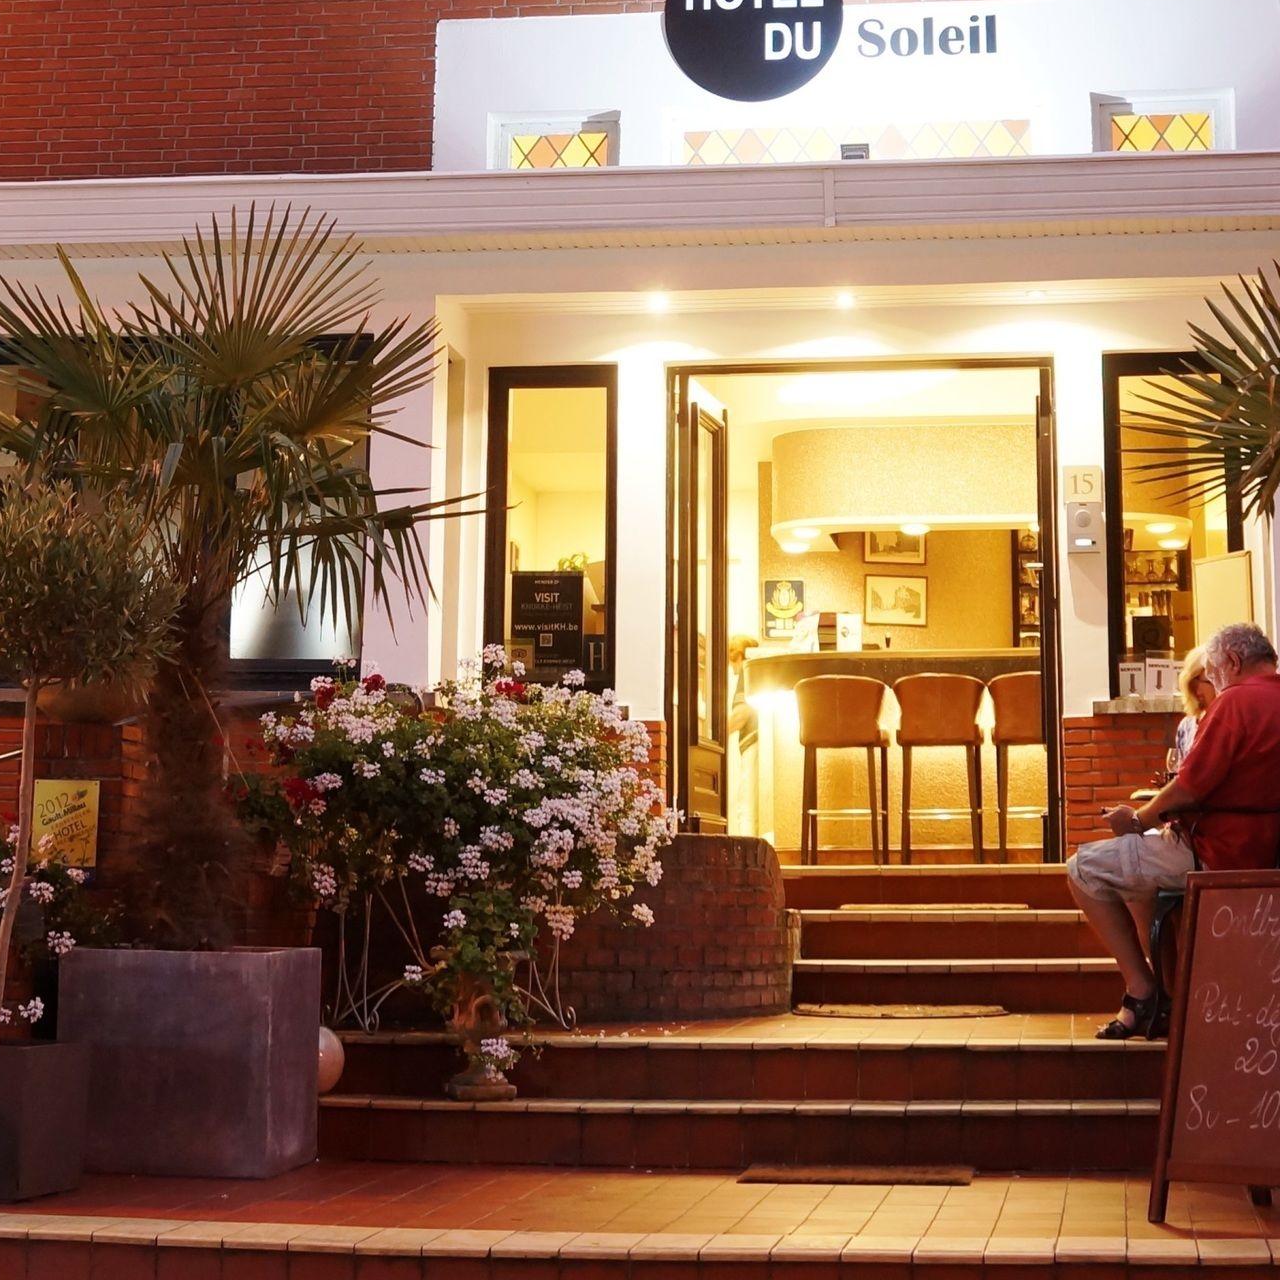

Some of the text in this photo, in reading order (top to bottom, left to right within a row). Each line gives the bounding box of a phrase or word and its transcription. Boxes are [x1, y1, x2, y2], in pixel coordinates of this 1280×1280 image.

[764, 14, 997, 61] DU Soleil
[1071, 473, 1094, 495] 15
[534, 592, 560, 603] VISIT
[514, 622, 579, 631] www.visitKH.be
[37, 792, 72, 819] 2012
[53, 819, 87, 840] HOTEL
